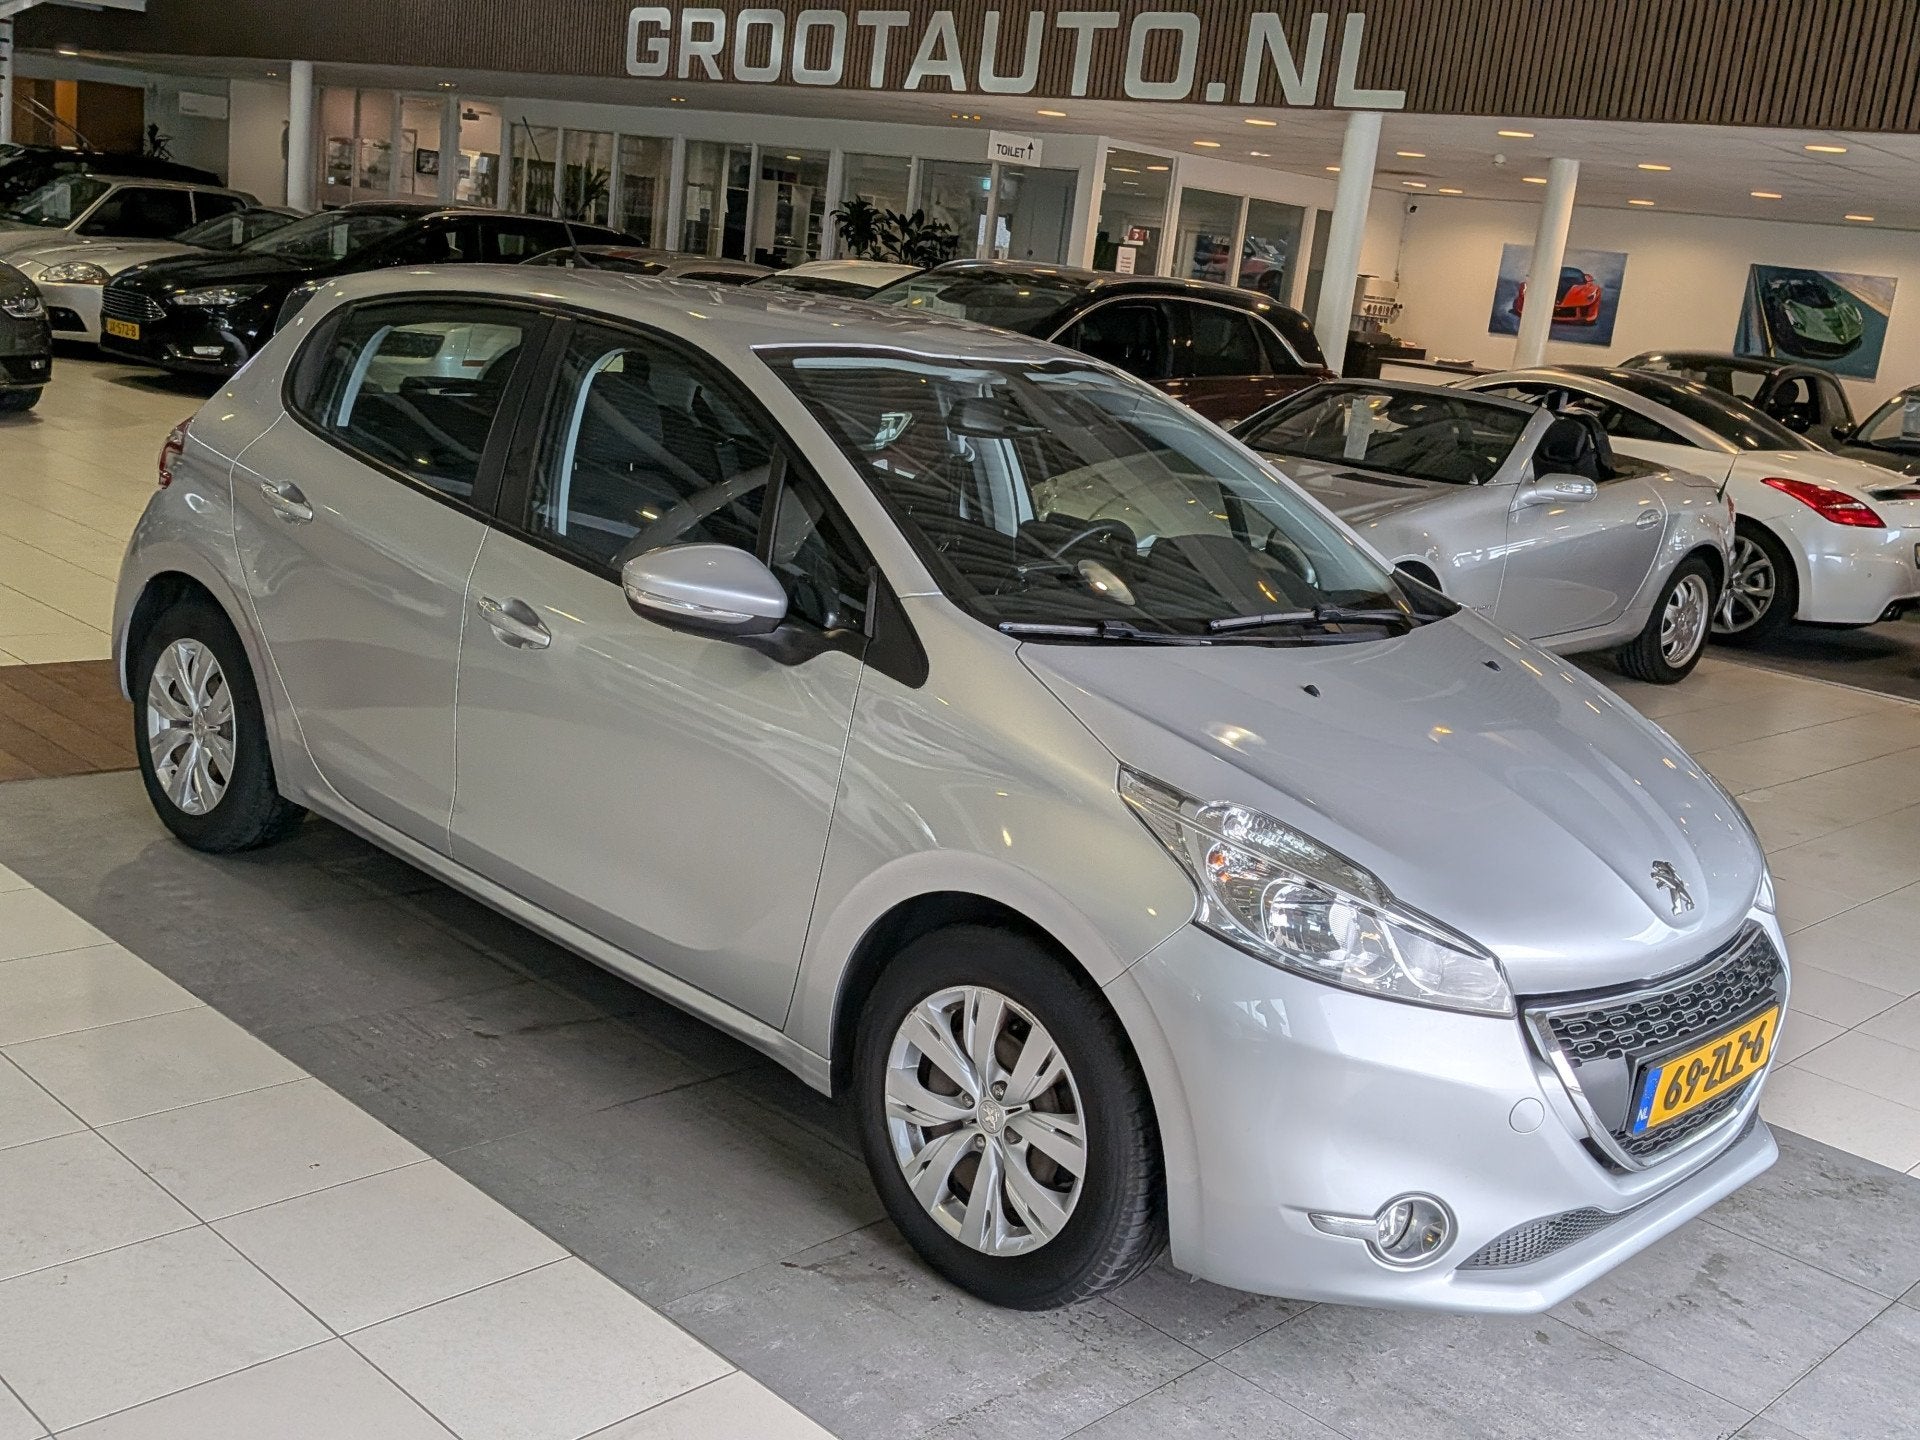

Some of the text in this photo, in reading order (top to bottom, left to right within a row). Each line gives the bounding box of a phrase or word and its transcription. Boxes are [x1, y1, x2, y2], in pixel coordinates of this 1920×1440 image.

[626, 7, 1406, 109] GROOTAUTO.NL
[996, 143, 1026, 159] TOILET
[1663, 1020, 1768, 1111] 69-ZLZ-6
